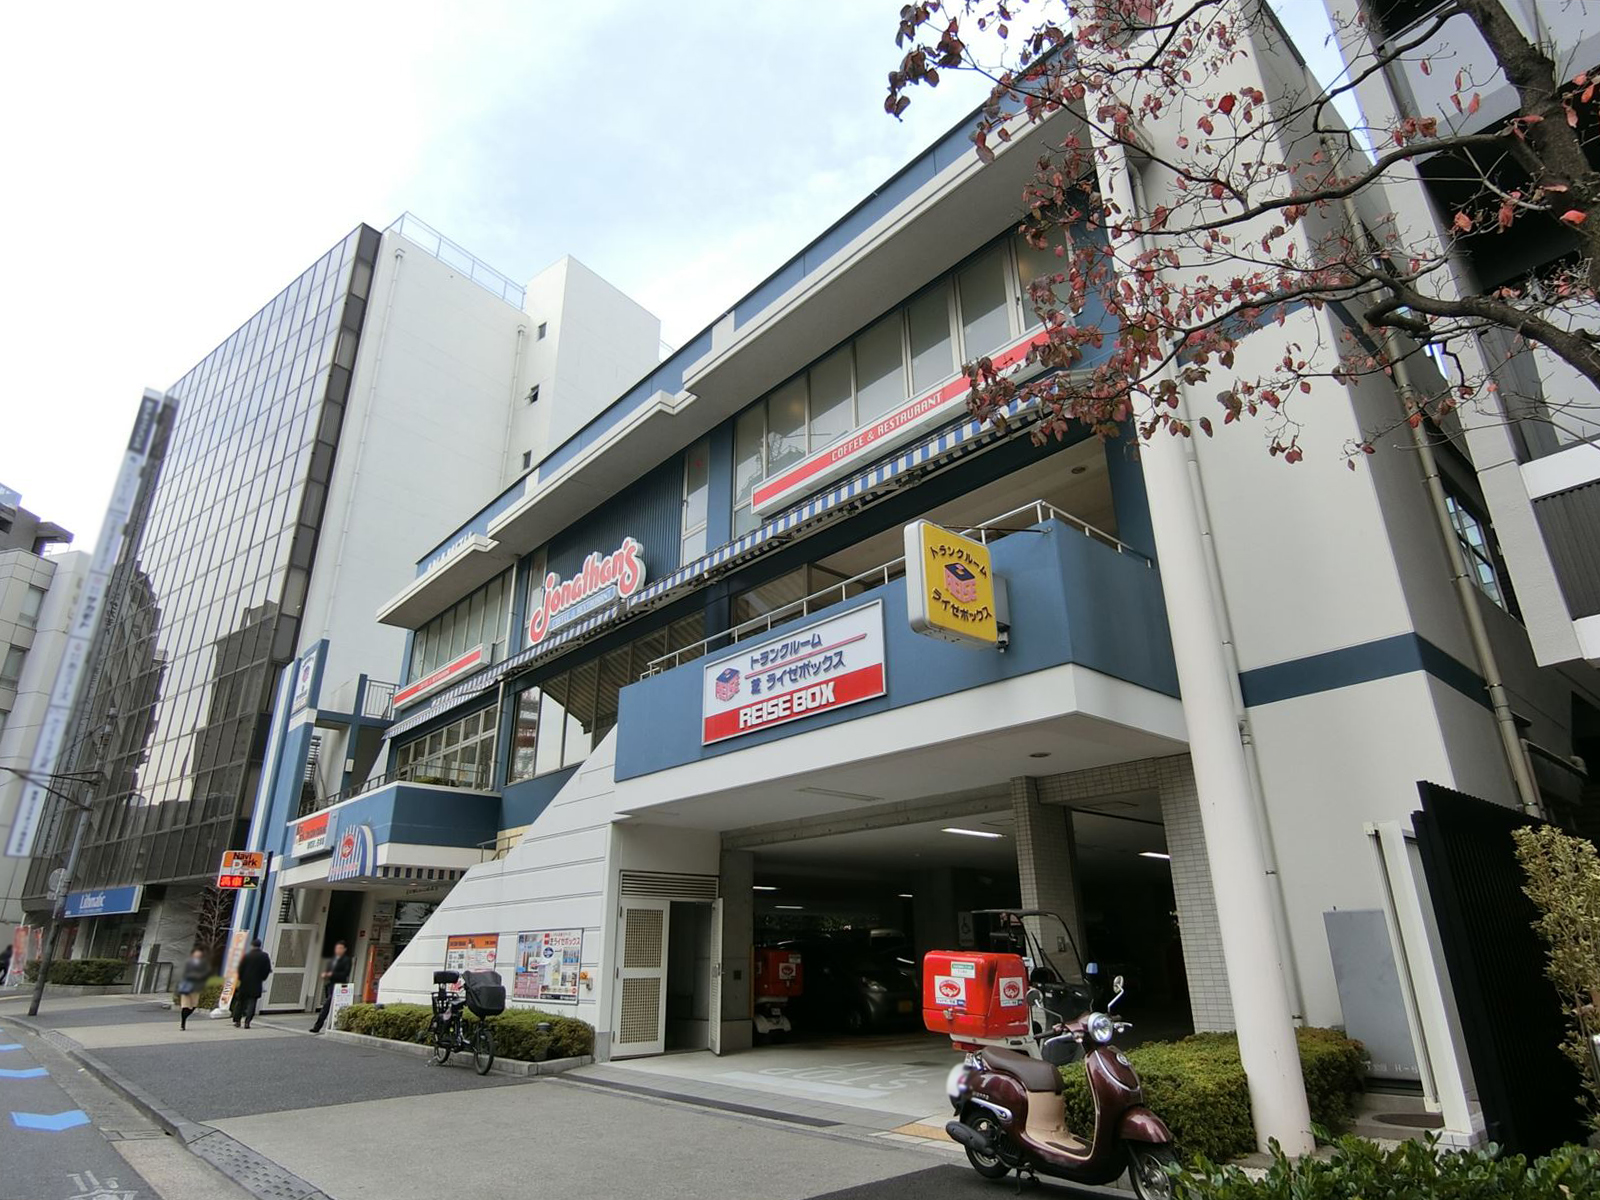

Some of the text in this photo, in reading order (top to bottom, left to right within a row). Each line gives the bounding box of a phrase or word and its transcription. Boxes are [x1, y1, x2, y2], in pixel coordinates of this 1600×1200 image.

[831, 391, 943, 461] COFFEE & RESTAURANT
[930, 544, 988, 580] トランクルーム
[932, 588, 992, 622] ライゼボックス
[750, 633, 823, 670] トランクルーム
[766, 650, 846, 692] ライゼボックス
[739, 681, 836, 729] REISE BOX
